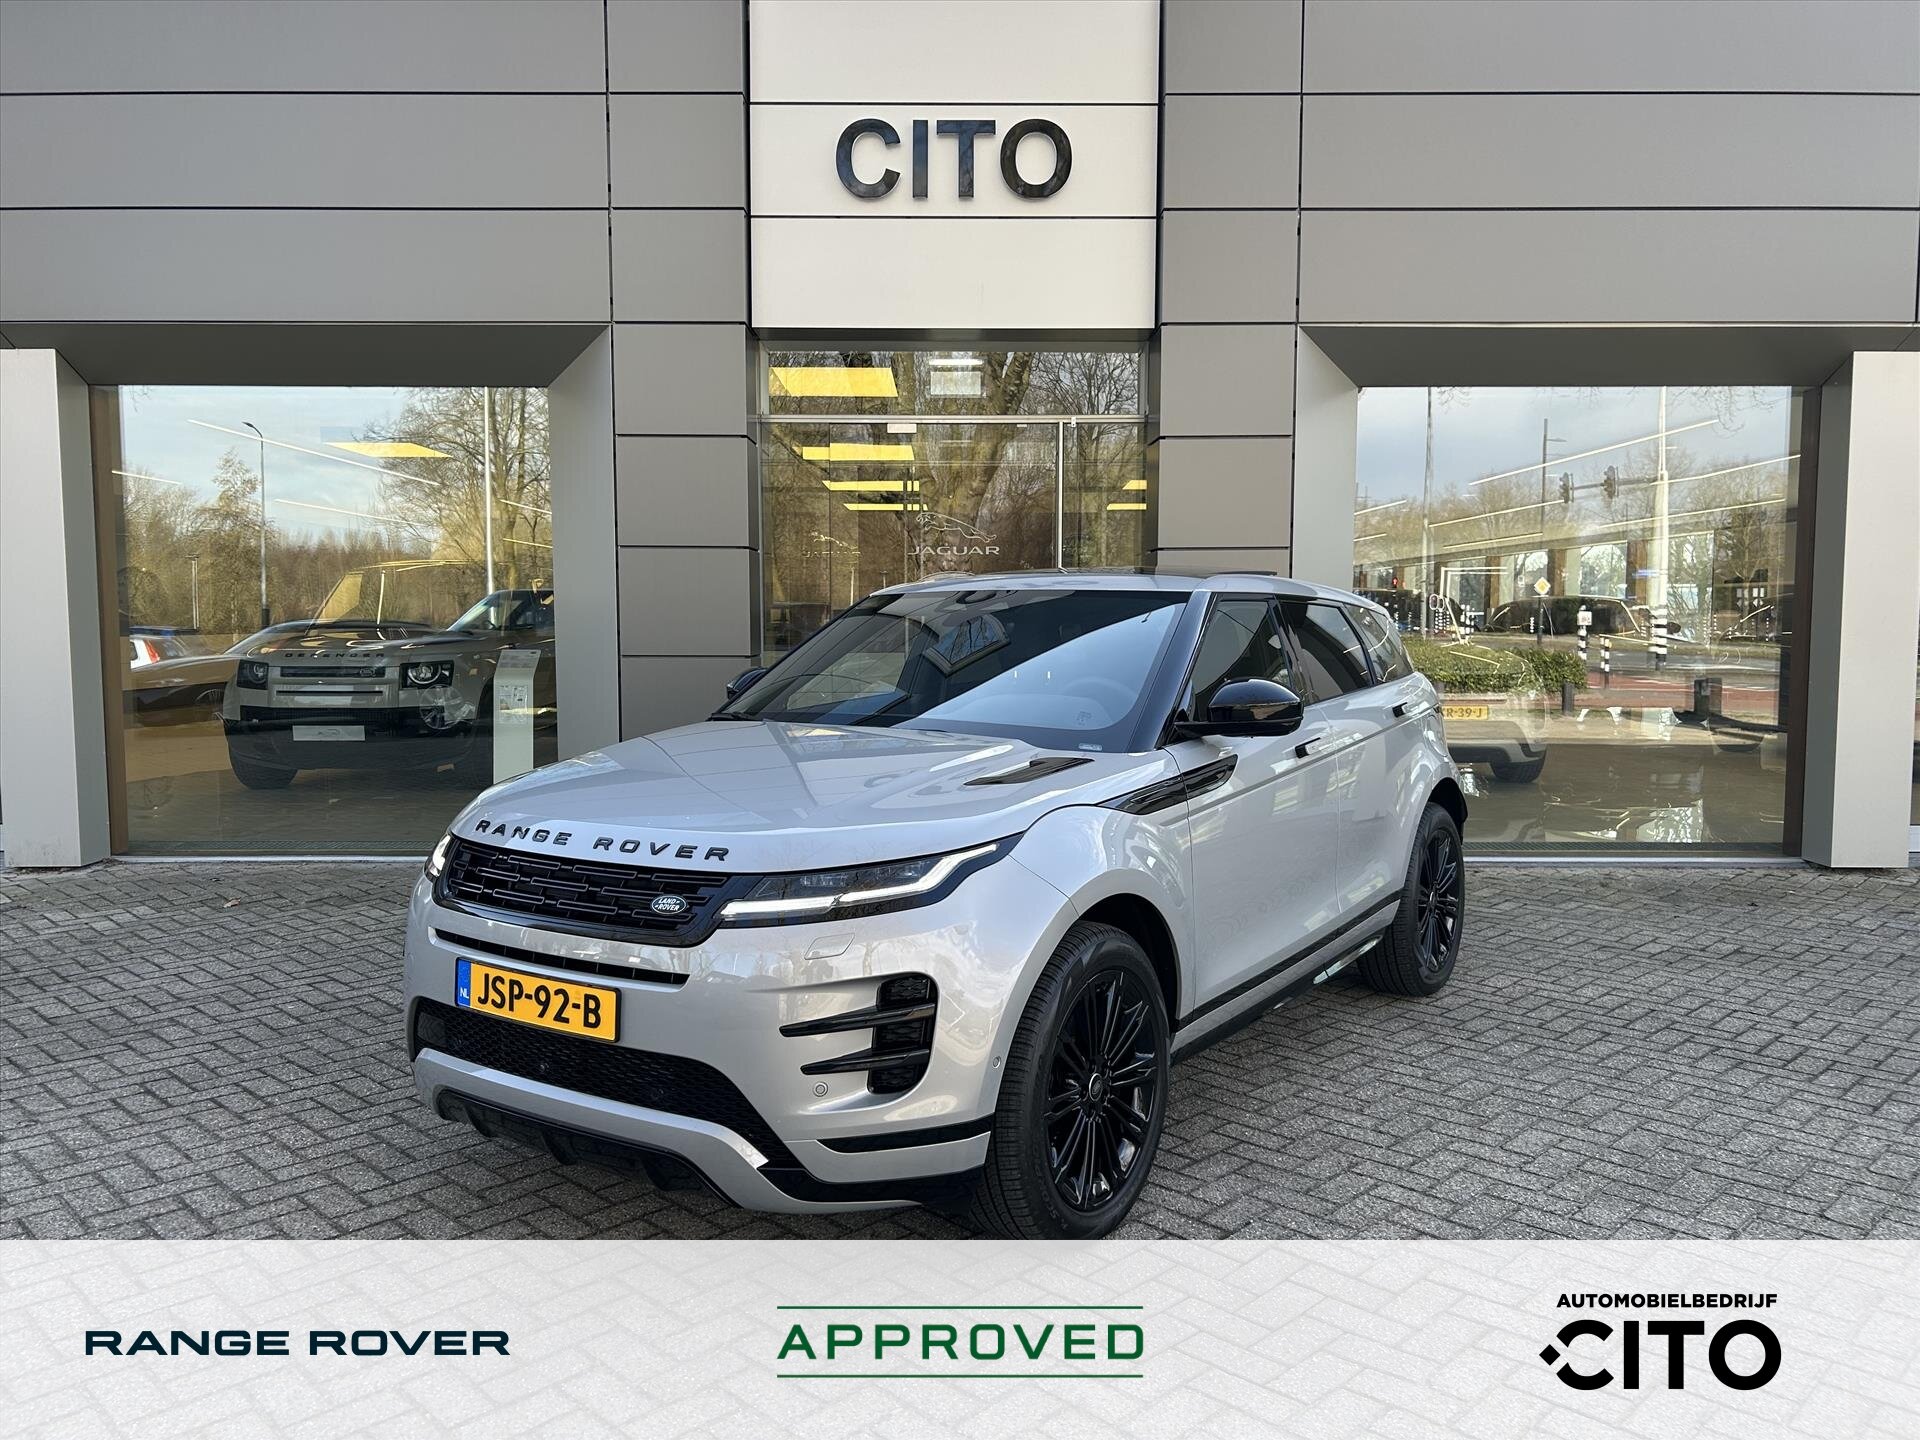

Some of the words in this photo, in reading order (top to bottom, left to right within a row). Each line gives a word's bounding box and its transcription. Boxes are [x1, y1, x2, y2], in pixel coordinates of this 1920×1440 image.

[836, 118, 1073, 199] CITO
[907, 545, 1000, 556] JAGUAR
[475, 819, 573, 846] RANGE
[593, 836, 730, 862] ROVER
[459, 987, 470, 999] NL
[477, 972, 602, 1029] JSP-92-B
